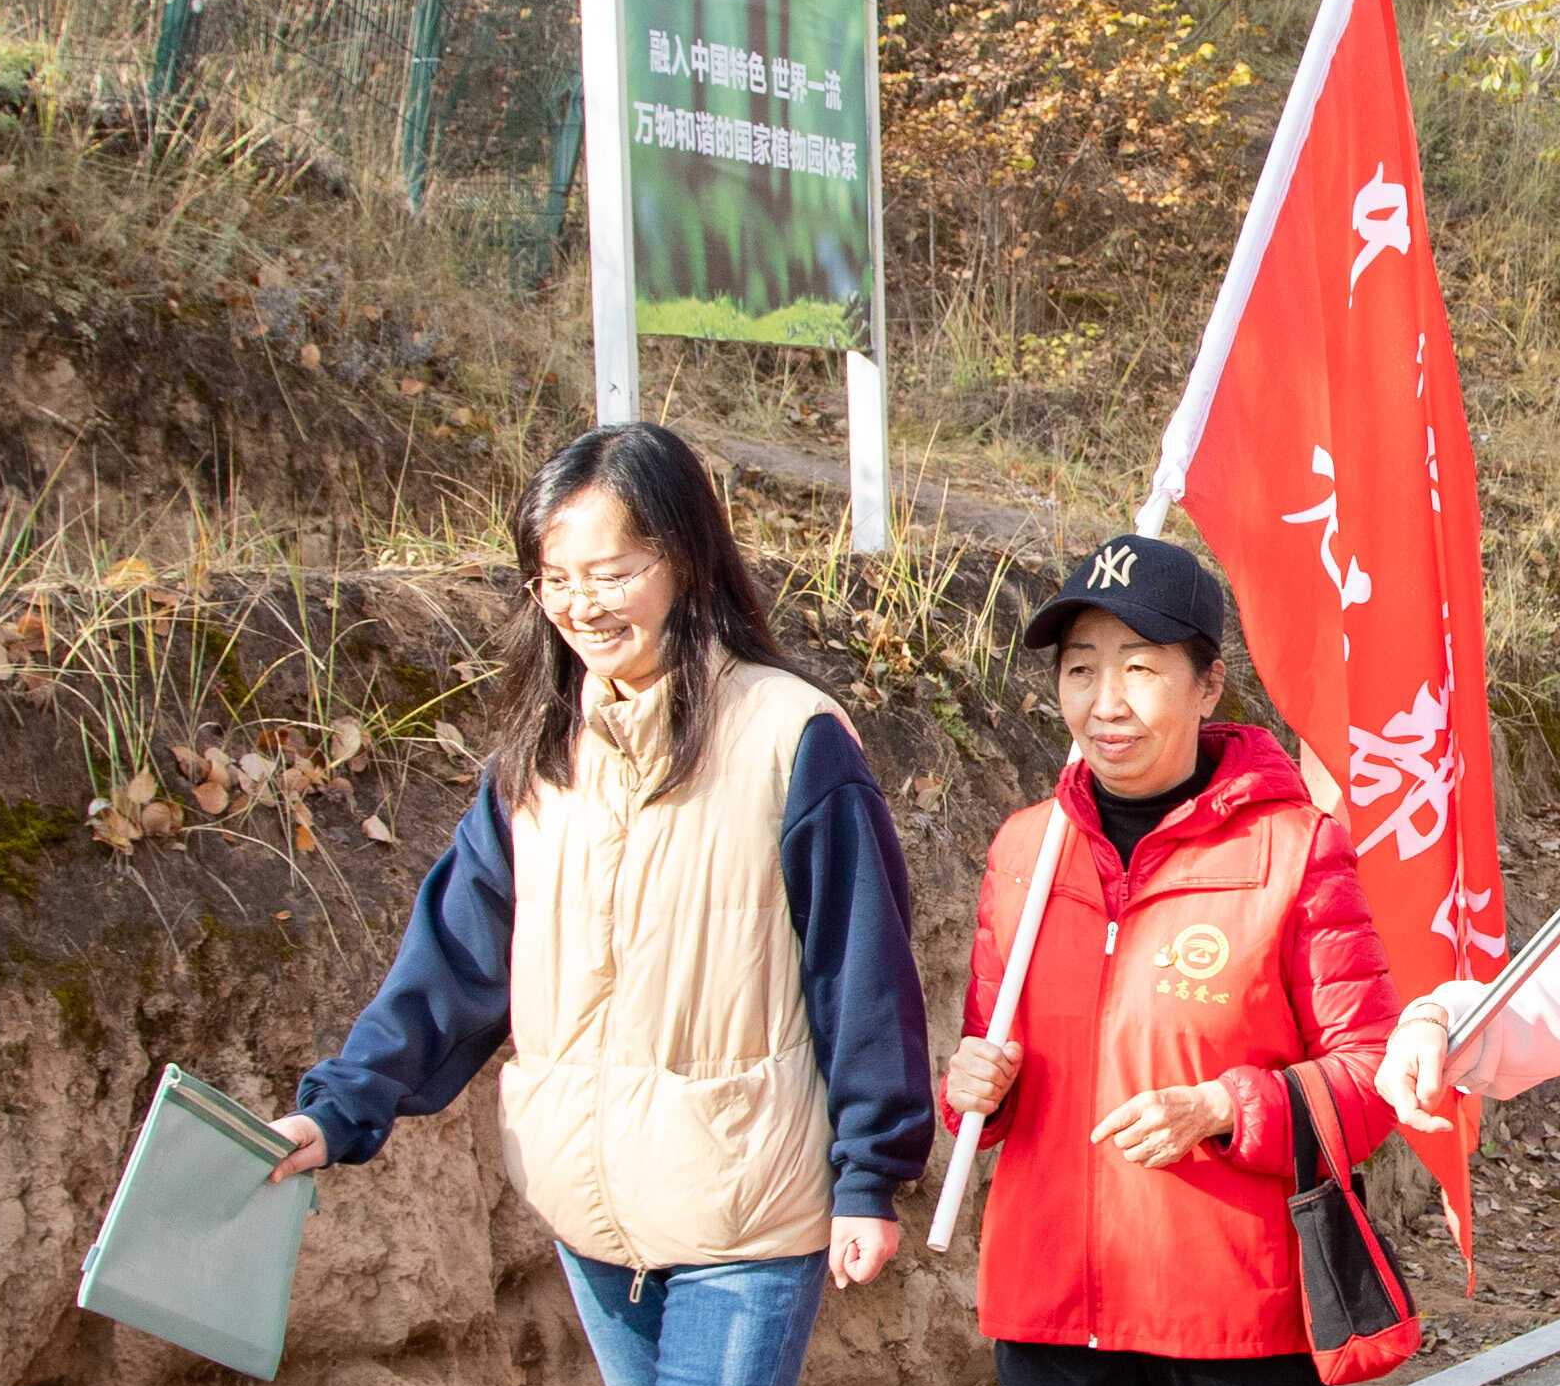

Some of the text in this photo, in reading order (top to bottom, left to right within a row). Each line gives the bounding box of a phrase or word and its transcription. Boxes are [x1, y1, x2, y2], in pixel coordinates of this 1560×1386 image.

[649, 29, 843, 111] 融入中国特色 世界一流
[633, 101, 858, 182] 万物和谐的国家植物园体系
[1086, 544, 1138, 590] NY
[1155, 979, 1230, 1005] 西高爱心
